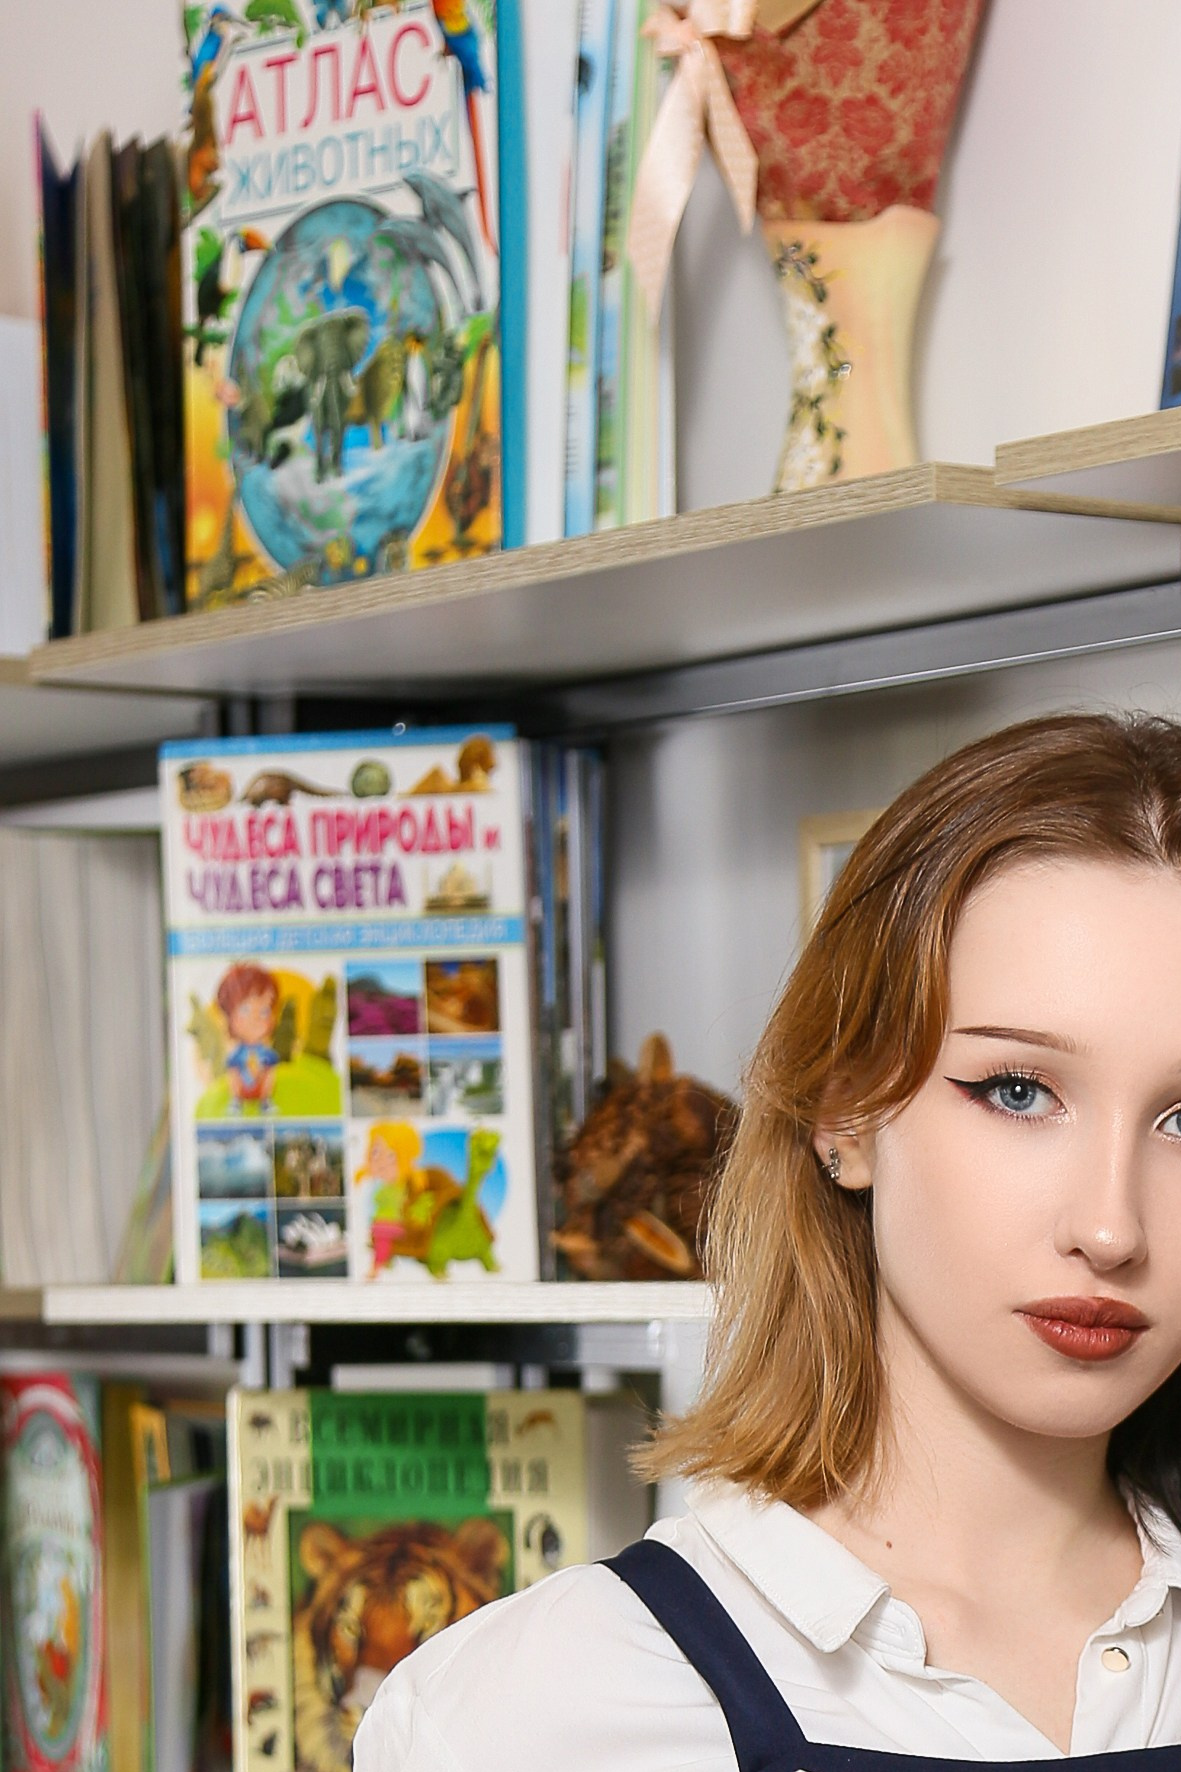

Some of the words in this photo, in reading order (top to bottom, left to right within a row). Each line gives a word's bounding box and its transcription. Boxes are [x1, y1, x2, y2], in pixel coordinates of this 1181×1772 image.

[226, 22, 432, 146] АТЛАС
[228, 113, 455, 203] ЖИВОТНЫХ
[183, 807, 300, 862] ЧУДЕСА
[309, 803, 475, 857] ПРИРОДЫ
[187, 860, 305, 913] ЧУДЕСА
[312, 860, 407, 910] СВЕТА
